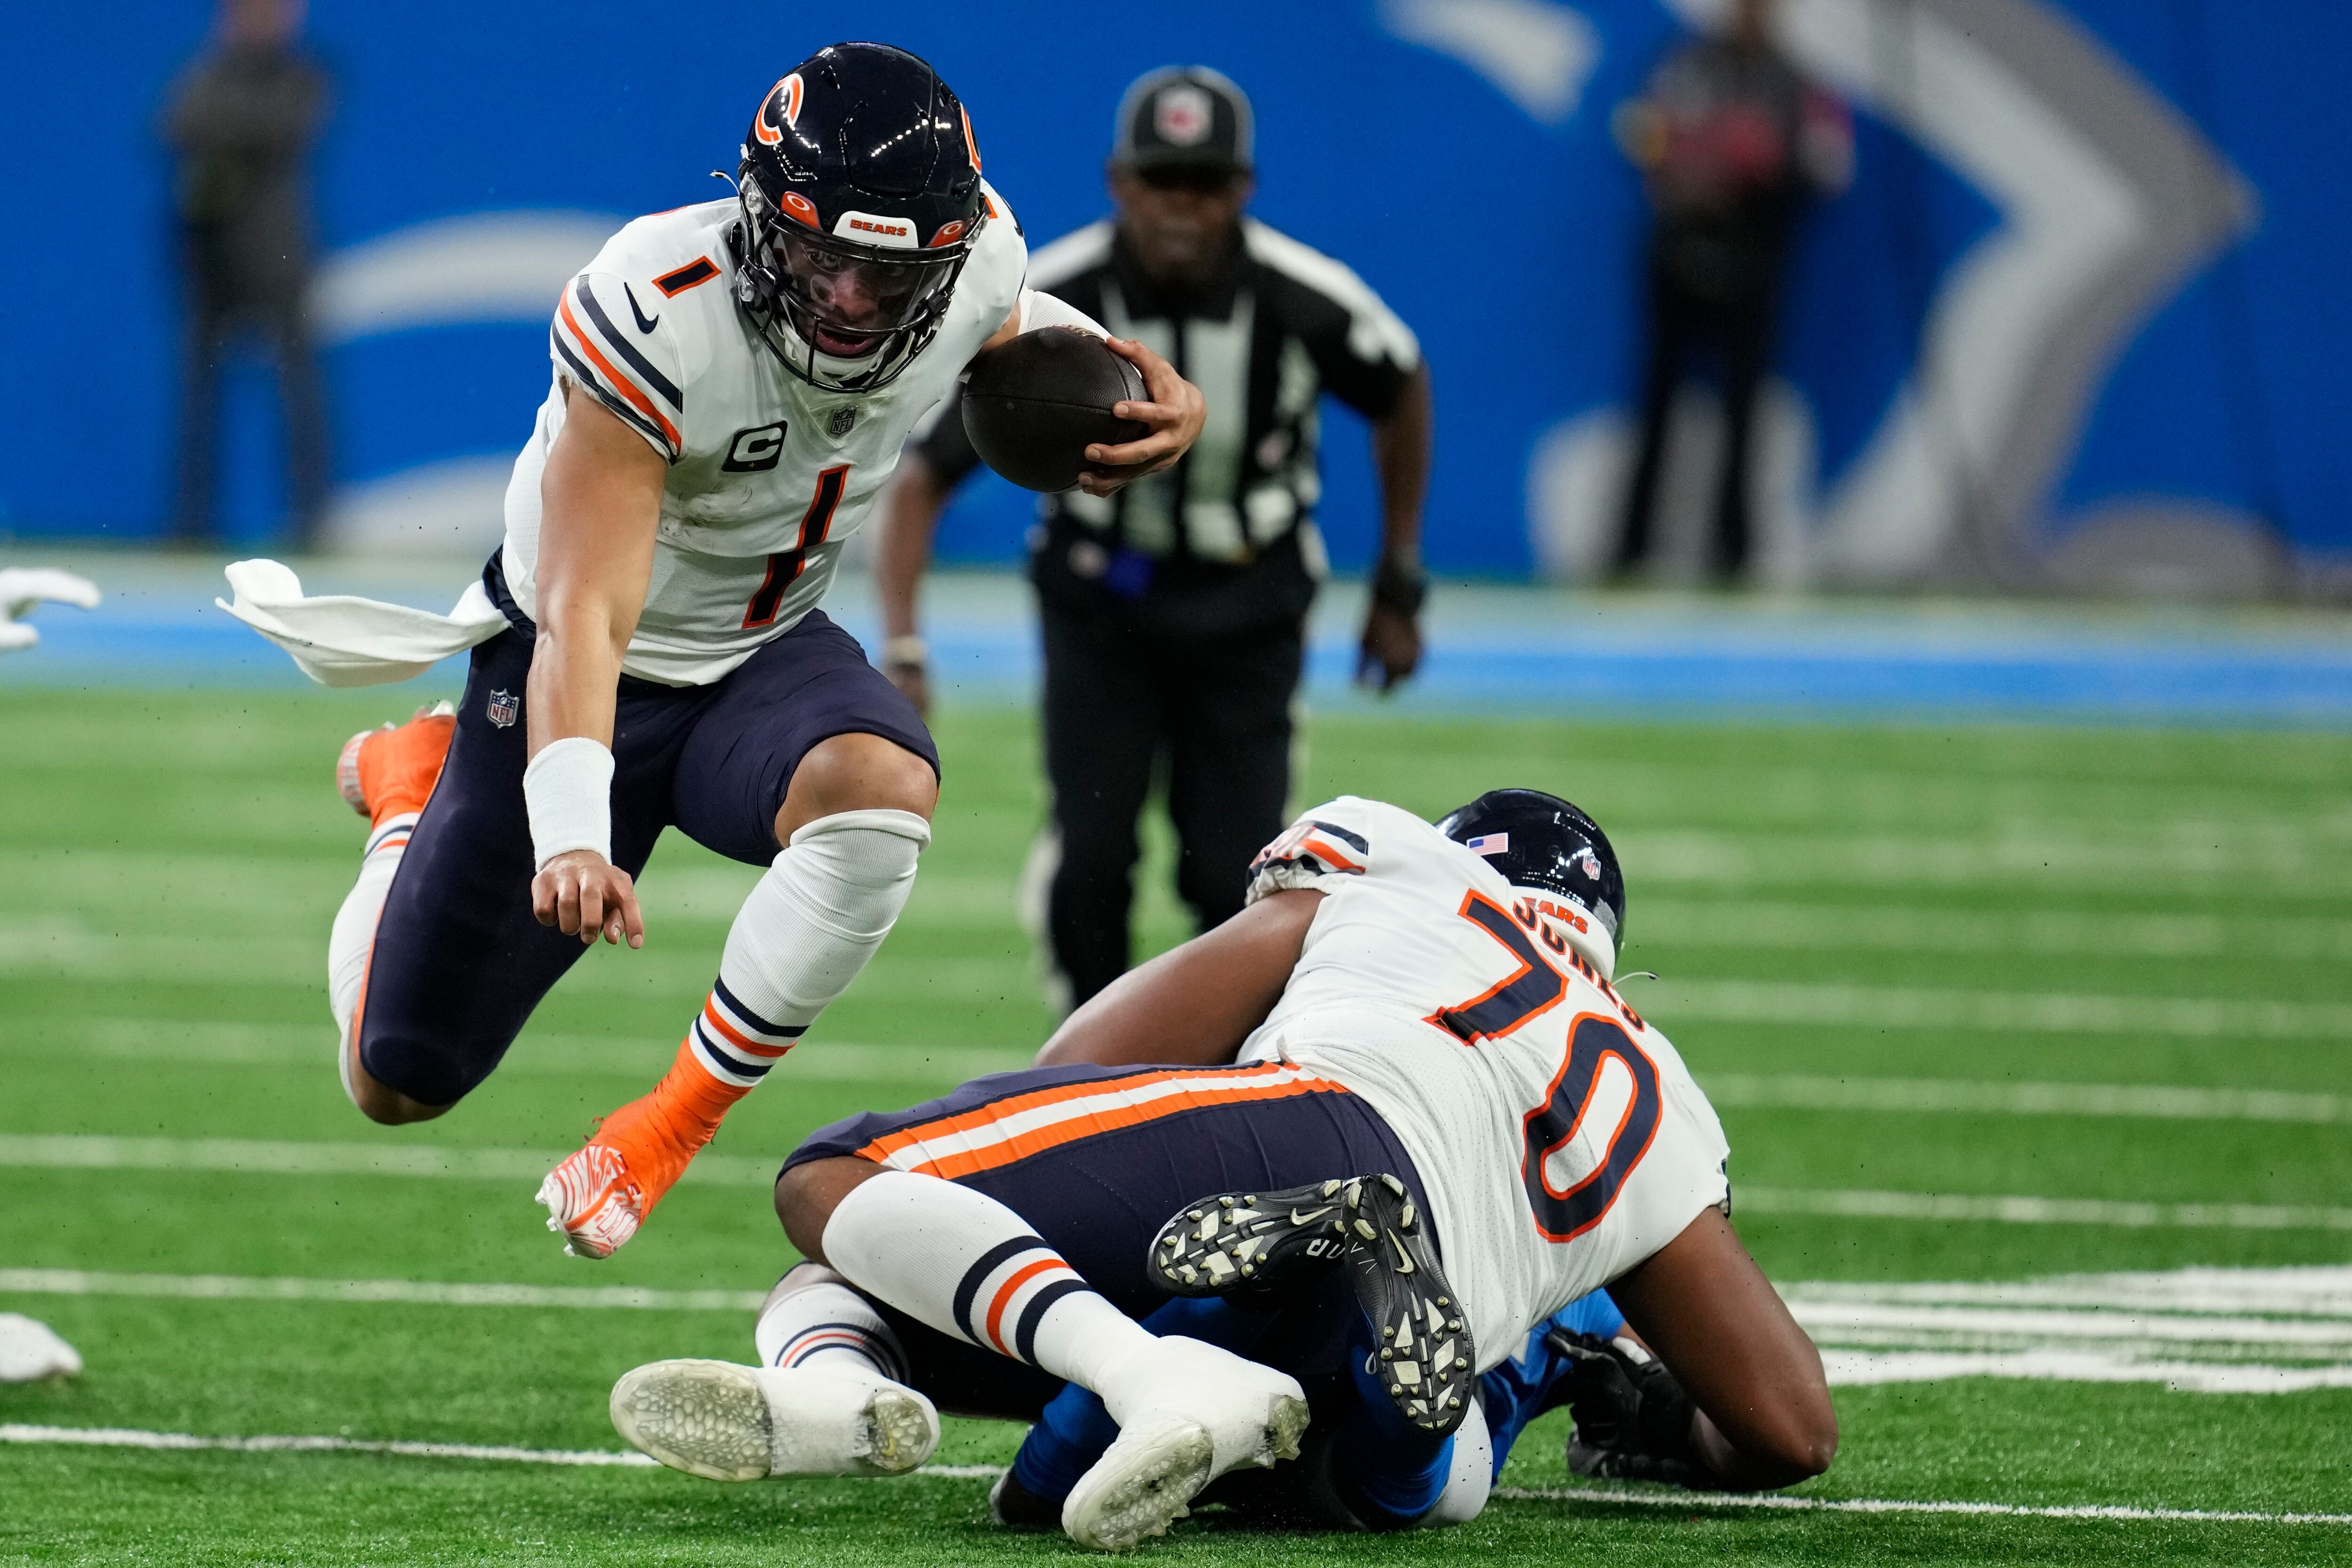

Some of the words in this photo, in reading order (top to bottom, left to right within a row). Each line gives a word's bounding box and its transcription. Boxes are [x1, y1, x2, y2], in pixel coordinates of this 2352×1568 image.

[850, 219, 906, 236] BEARS
[652, 255, 722, 299] 1
[833, 419, 850, 432] NFL
[733, 427, 782, 462] C
[742, 463, 850, 629] 1
[492, 705, 511, 721] NFL
[1585, 861, 1598, 877] NFL
[1422, 888, 1662, 1243] 70
